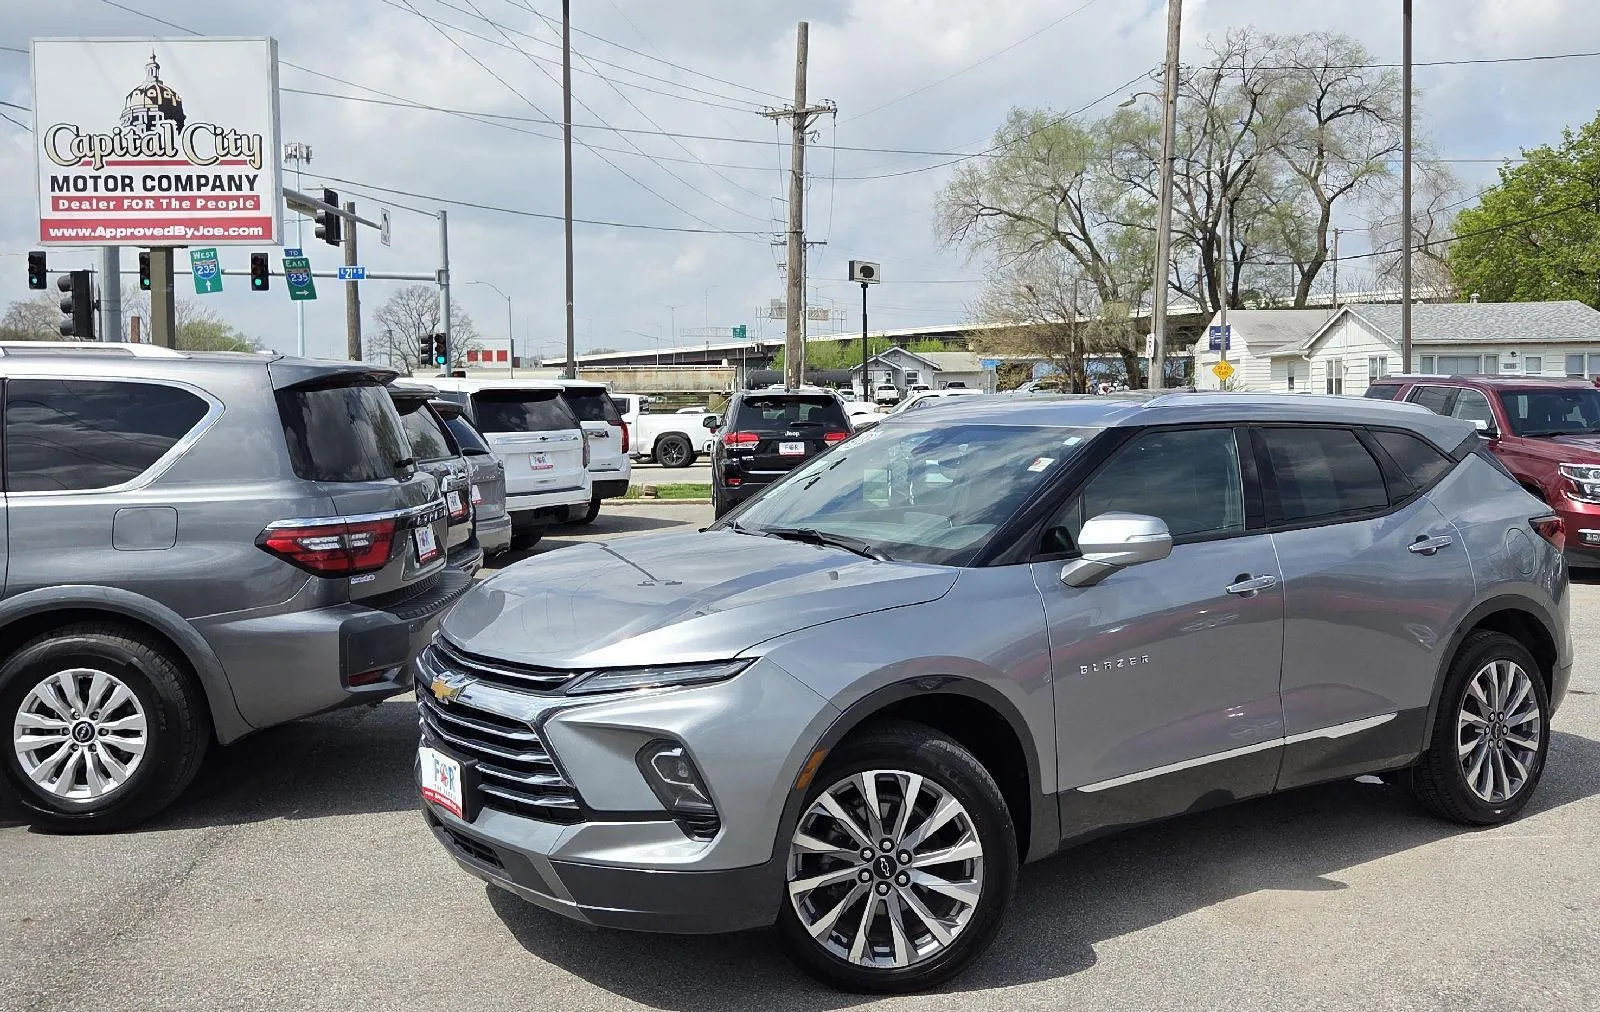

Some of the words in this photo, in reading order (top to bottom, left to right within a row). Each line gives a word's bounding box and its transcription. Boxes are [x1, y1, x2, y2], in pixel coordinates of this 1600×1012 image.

[44, 122, 178, 170] Capital
[182, 122, 262, 170] City
[50, 174, 135, 193] MOTOR
[142, 174, 259, 192] COMPANY
[58, 198, 115, 210] Dealer
[123, 198, 155, 210] FOR
[160, 198, 191, 209] The
[196, 198, 255, 211] People
[49, 225, 263, 239] www.ApprovedByJoe.com
[192, 250, 215, 259] WEST
[197, 264, 216, 275] 235
[285, 259, 307, 268] EAST
[290, 273, 309, 282] 235
[784, 430, 800, 438] Jeep
[1080, 654, 1149, 674] BLAZER
